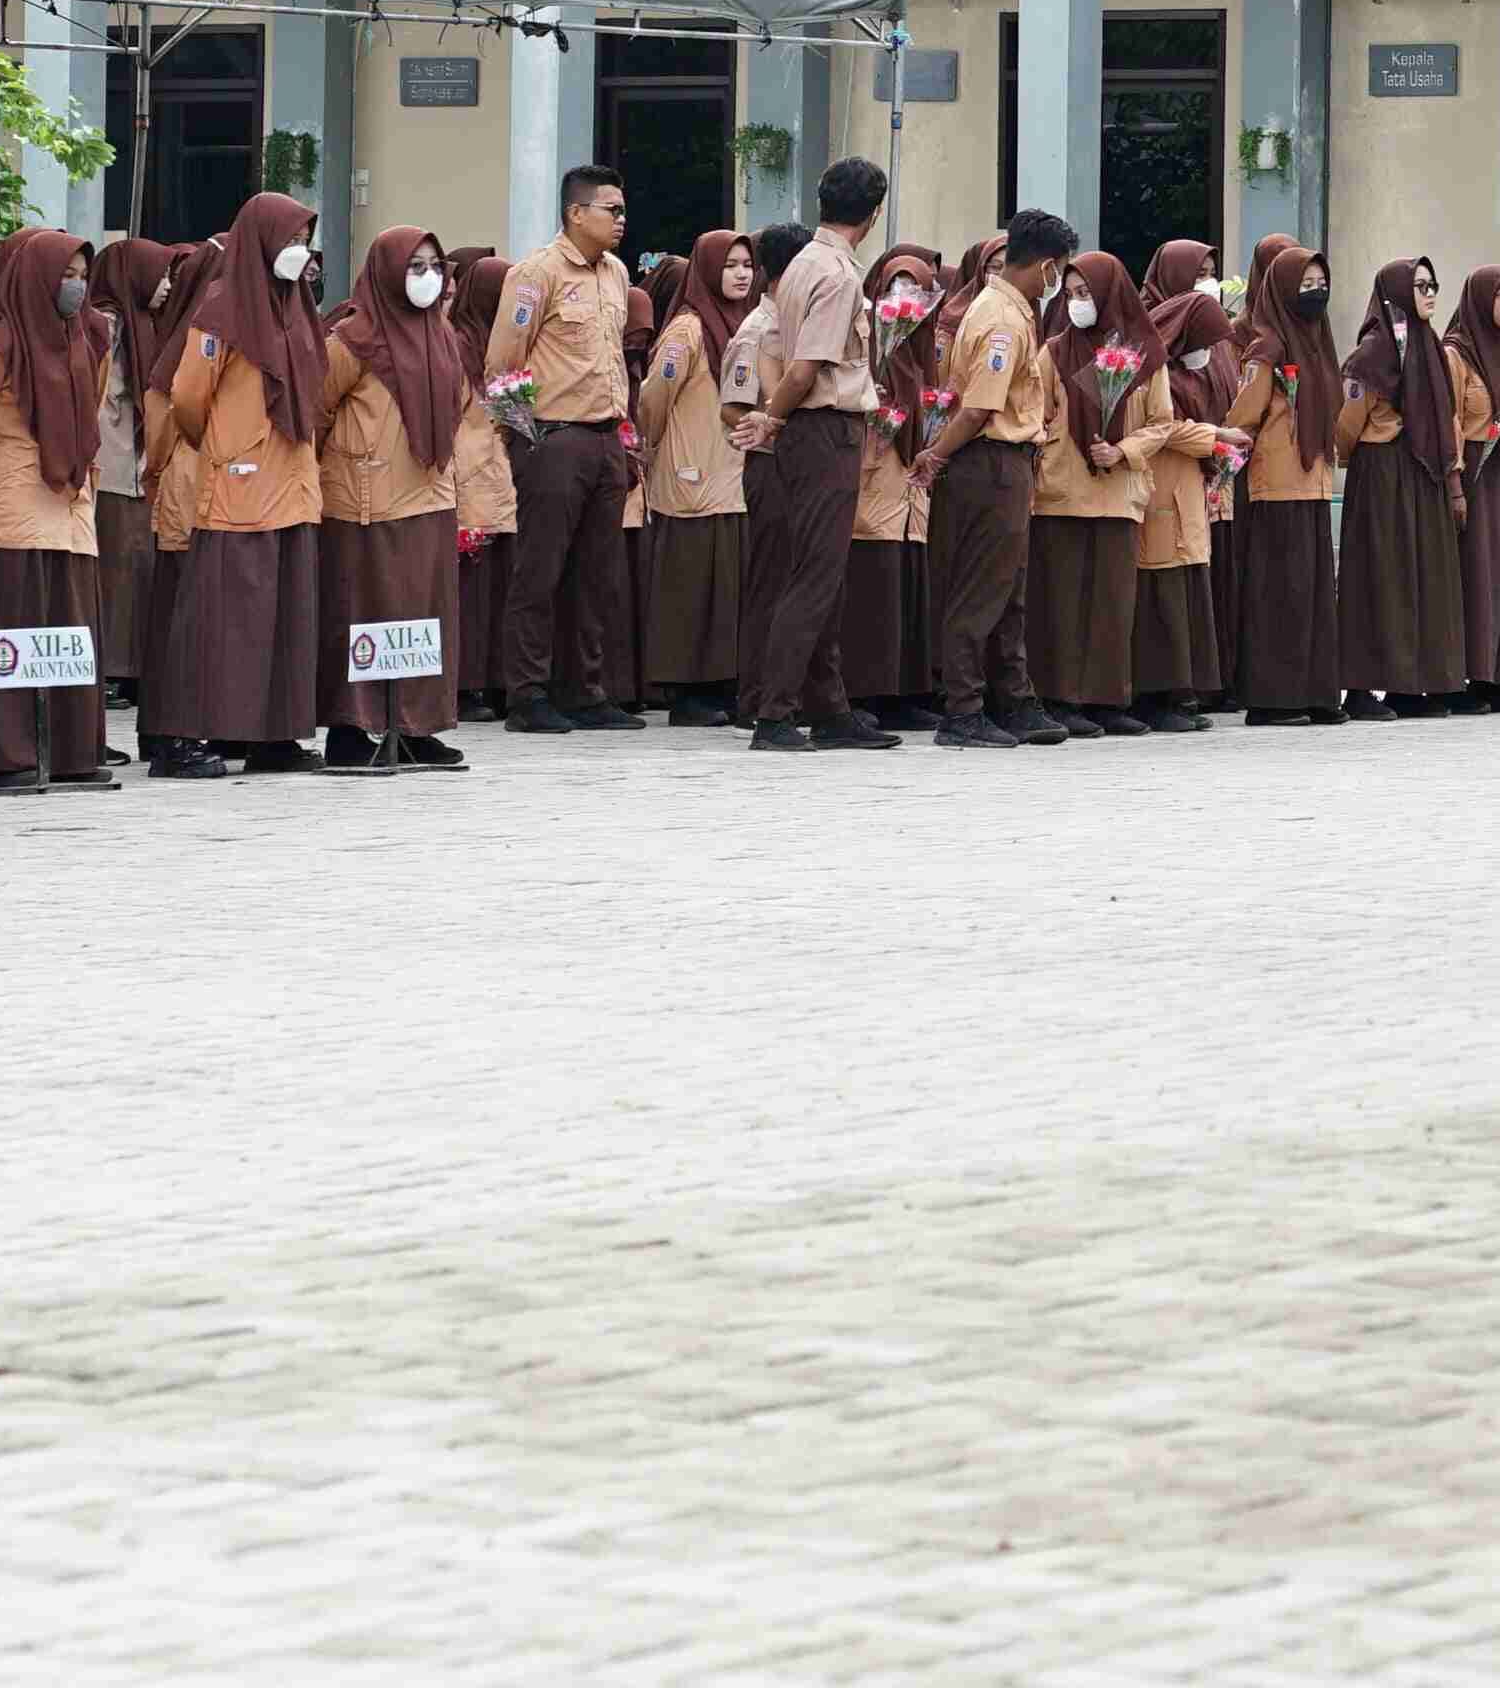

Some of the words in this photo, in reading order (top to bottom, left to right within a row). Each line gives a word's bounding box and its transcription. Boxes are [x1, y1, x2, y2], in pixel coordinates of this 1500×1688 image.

[1391, 50, 1434, 67] Kepala
[1381, 70, 1405, 87] Tata
[1409, 70, 1444, 87] Usaha
[29, 634, 84, 658] XII-B
[382, 624, 433, 649] XII-A
[21, 660, 94, 679] AKUNTANSI
